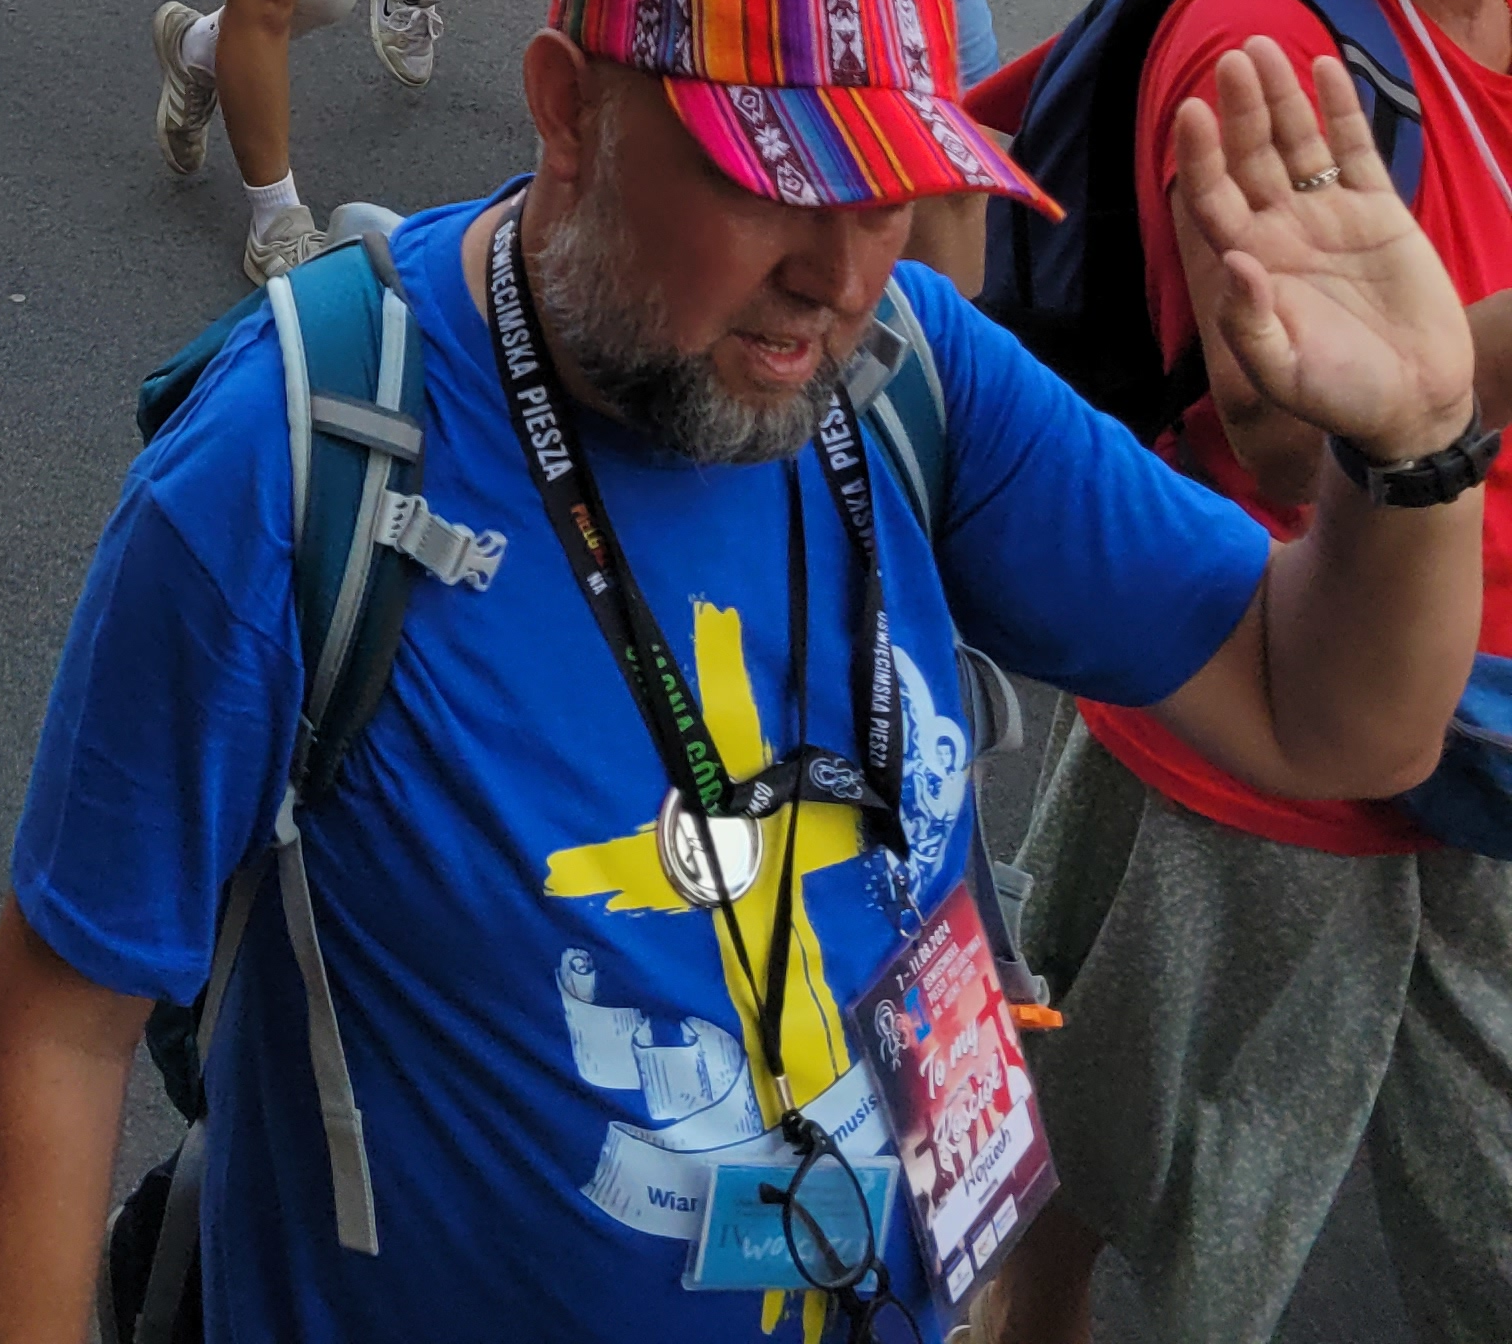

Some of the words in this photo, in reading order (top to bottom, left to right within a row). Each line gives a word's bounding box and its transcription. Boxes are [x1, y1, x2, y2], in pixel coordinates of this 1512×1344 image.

[517, 384, 574, 483] PIESZA
[587, 570, 609, 596] NA
[919, 1046, 947, 1099] To
[950, 1018, 979, 1068] my
[647, 1185, 699, 1212] Wiar
[833, 1093, 878, 1144] musis
